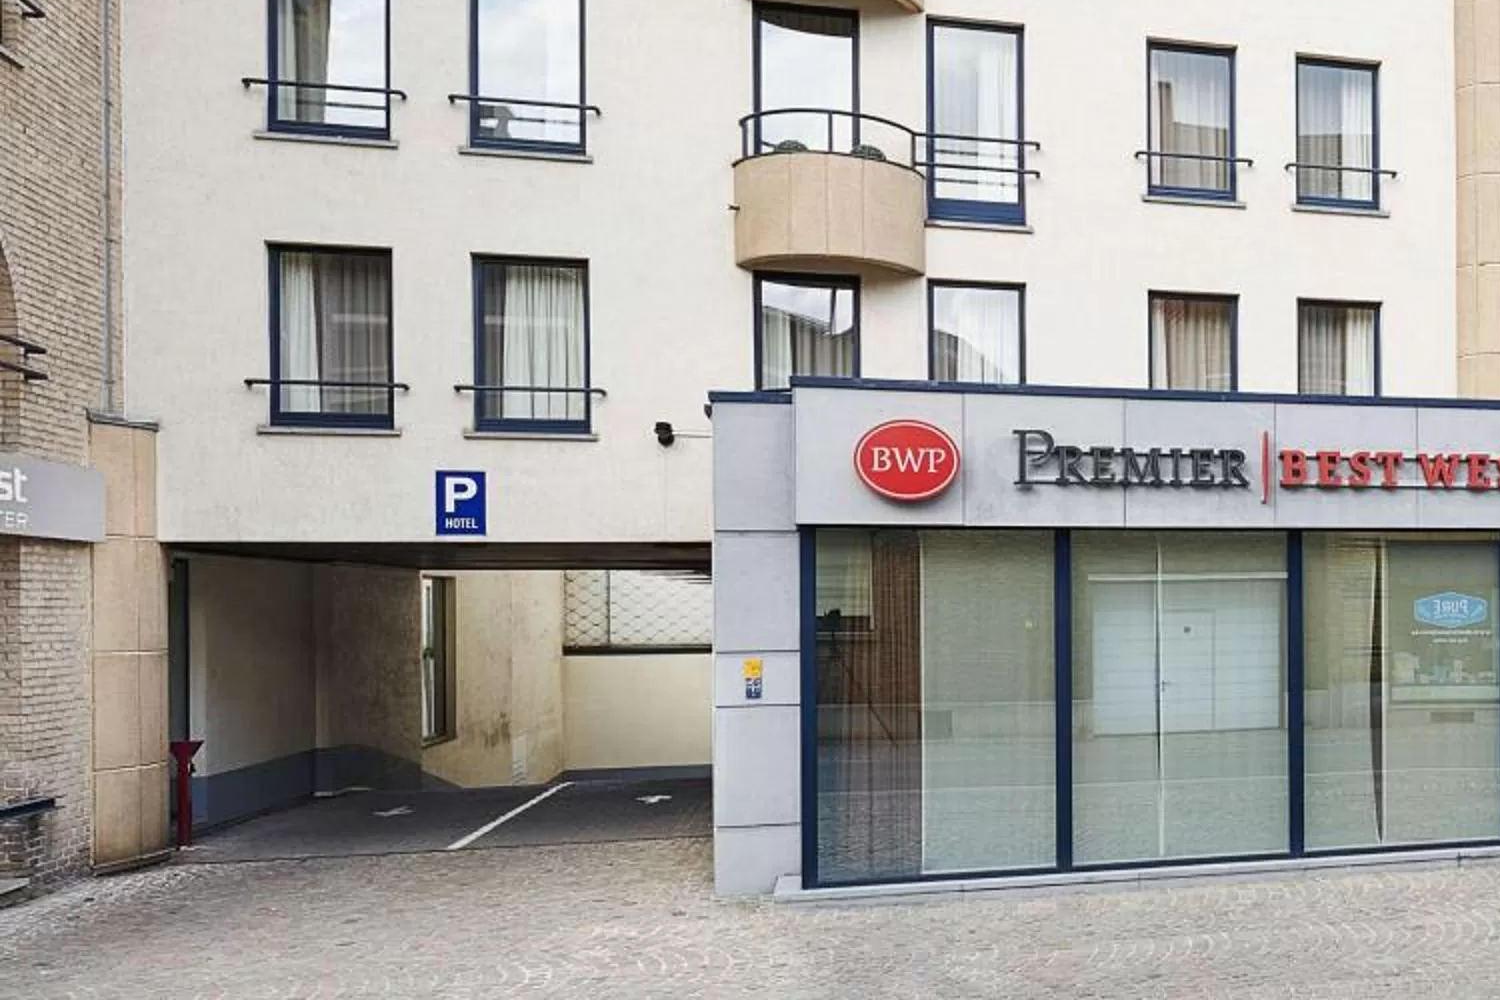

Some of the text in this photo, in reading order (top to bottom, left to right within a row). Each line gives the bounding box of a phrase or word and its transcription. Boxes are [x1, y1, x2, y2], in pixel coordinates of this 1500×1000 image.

[870, 446, 946, 474] BWP
[1011, 428, 1250, 490] PREMIER
[1278, 449, 1403, 489] BEST
[445, 477, 478, 513] P
[445, 517, 479, 529] HOTEL
